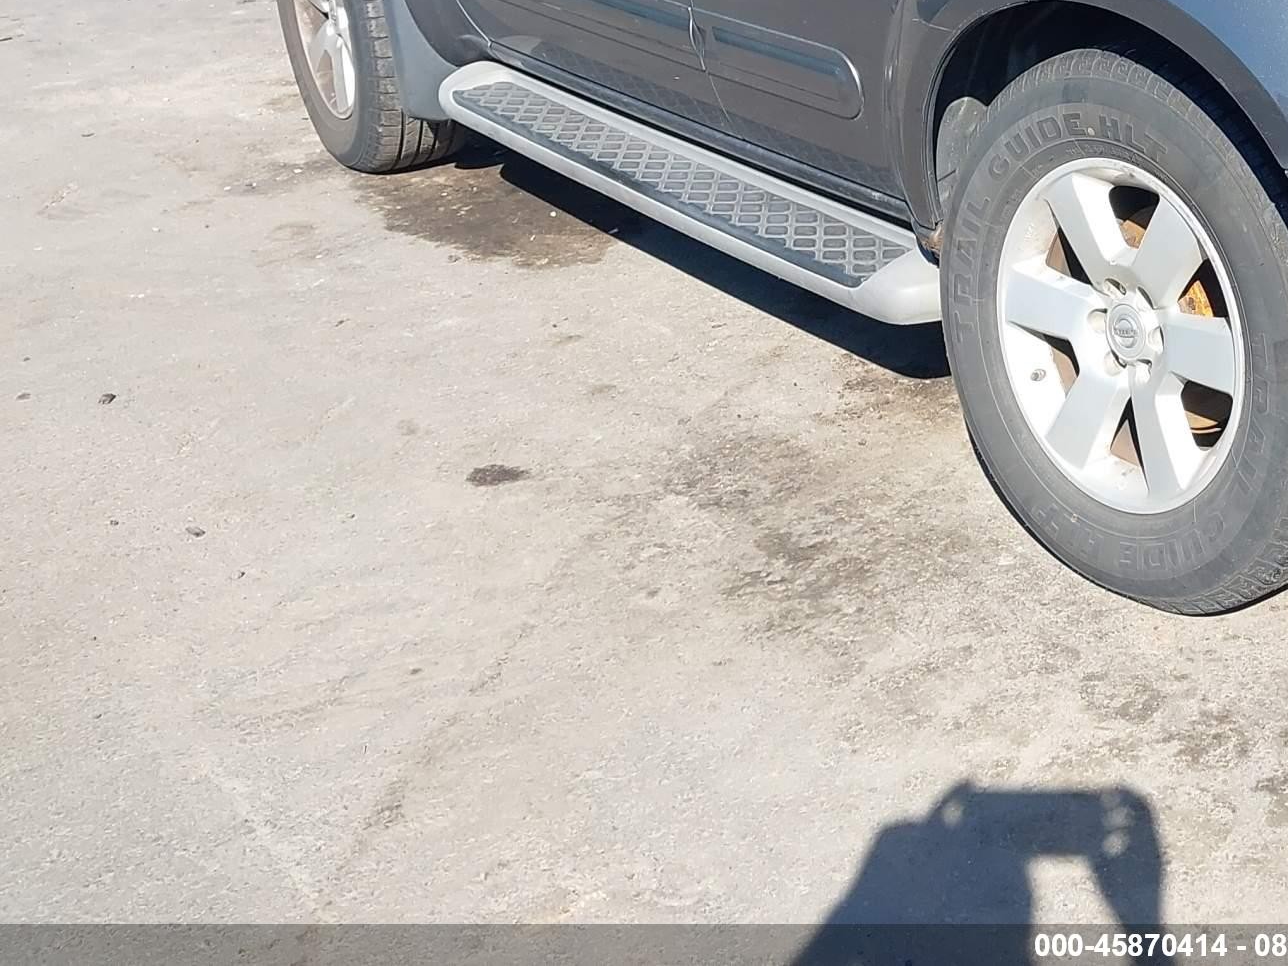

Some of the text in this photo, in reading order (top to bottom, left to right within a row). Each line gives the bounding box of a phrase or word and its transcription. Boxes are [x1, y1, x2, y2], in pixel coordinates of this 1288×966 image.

[951, 196, 991, 343] TRAIL
[988, 112, 1085, 181] GUIDE
[1098, 114, 1169, 164] HLT
